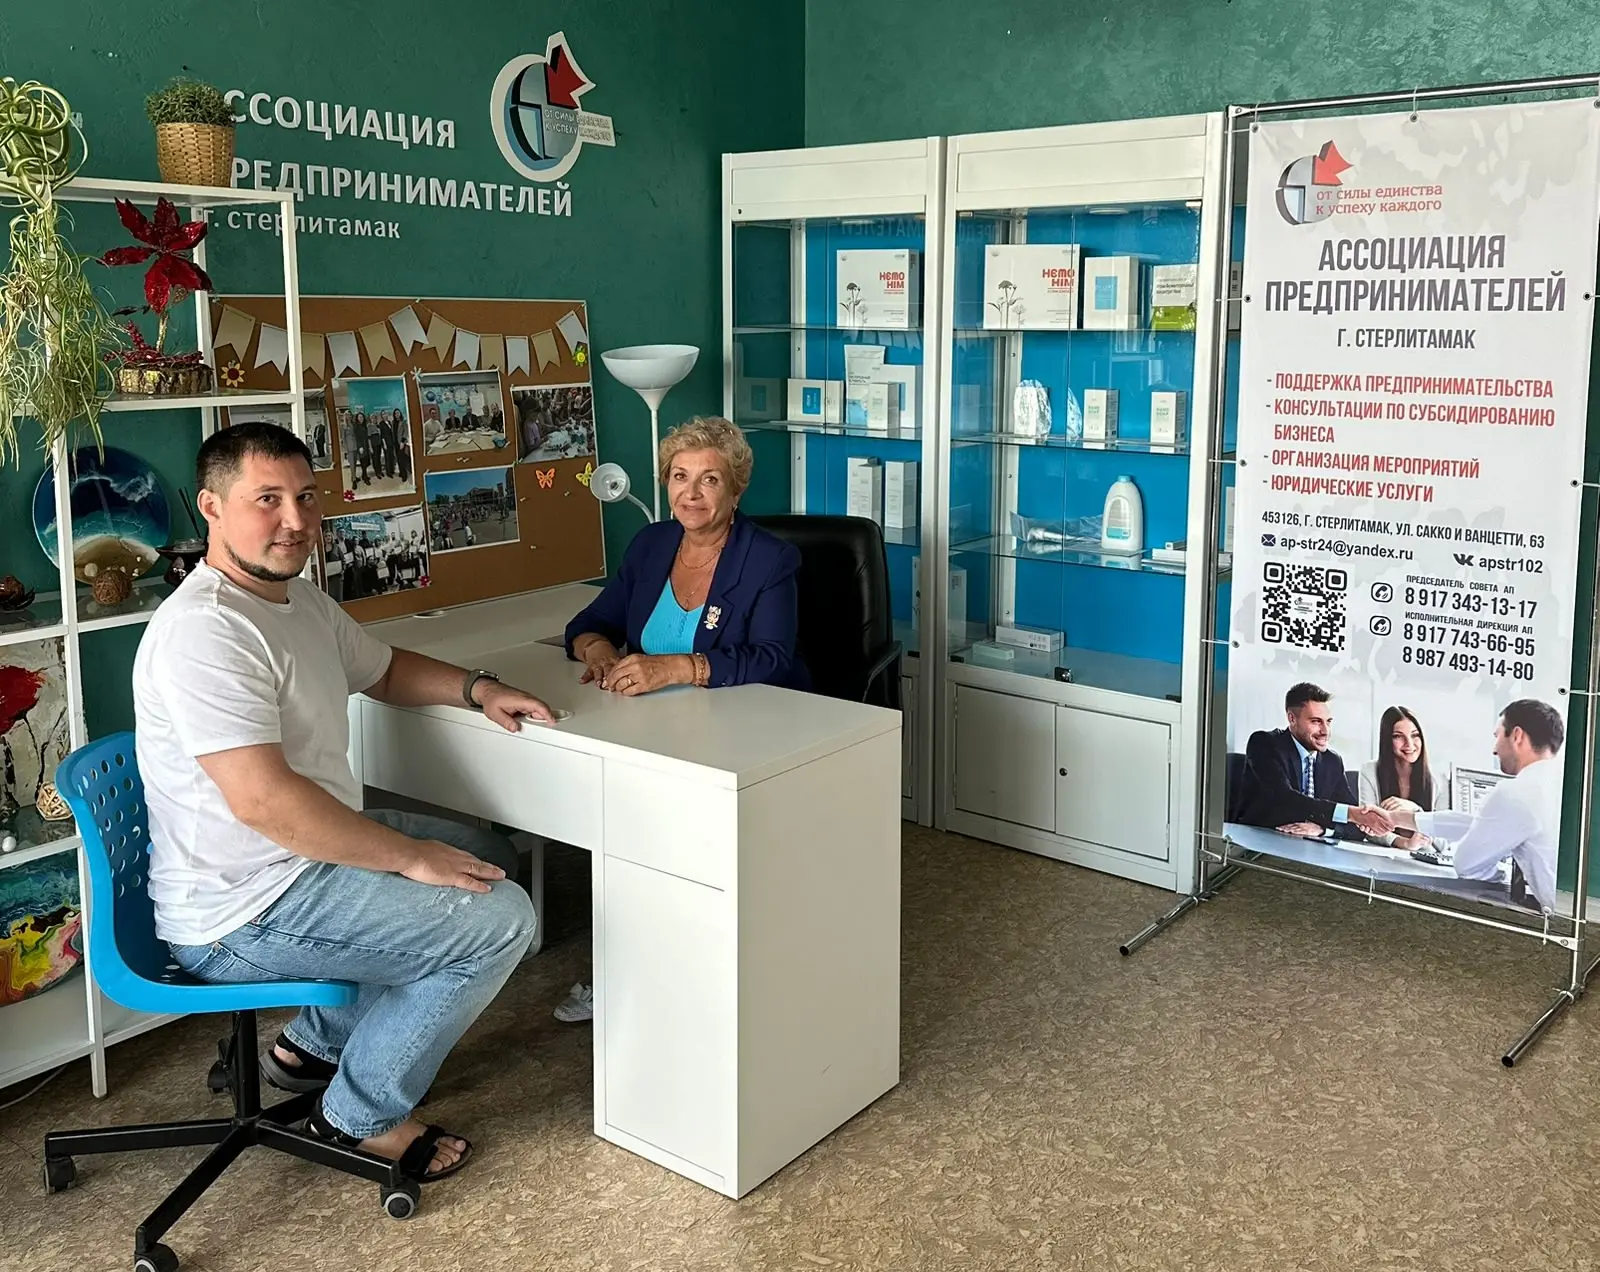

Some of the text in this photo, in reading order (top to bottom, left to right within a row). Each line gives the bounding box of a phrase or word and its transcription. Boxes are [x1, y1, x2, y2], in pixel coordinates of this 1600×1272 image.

[223, 89, 456, 149] ССОЦИАЦИЯ
[231, 157, 573, 217] РЕДПРИНИМАТЕЛЕЙ
[1317, 185, 1442, 200] от силы единства
[1316, 200, 1441, 217] к успеху каждого
[1318, 235, 1505, 273] АССОЦИАЦИЯ
[1266, 270, 1565, 315] ПРЕДПРИНИМАТЕЛЕЙ
[1338, 329, 1476, 349] Г. СТЕРЛИТАМАК
[1276, 373, 1361, 392] ПОДДЕРЖКА
[1366, 376, 1553, 397] ПРЕДПРИНИМАТЕЛЬСТВА
[1275, 399, 1382, 420] КОНСУЛЬТАЦИИ
[1387, 403, 1405, 420] ПО
[1409, 404, 1554, 426] СУБСИДИРОВАНИЮ
[1275, 424, 1334, 443] БИЗНЕСА
[1272, 450, 1369, 472] ОРГАНИЗАЦИЯ
[1374, 456, 1479, 478] МЕРОПРИЯТИЙ
[1272, 475, 1373, 497] ЮРИДИЧЕСКИЕ
[1377, 482, 1433, 502] УСЛУГИ
[1262, 511, 1544, 548] 453126, Г. СТЕРЛИТАМАК, УЛ. САККО И ВАНЦЕТТИ, 63
[1281, 538, 1413, 560] ap-str24@yandex.ru
[1479, 558, 1542, 573] apstr102
[1407, 575, 1514, 594] ПРЕДСЕДАТЕЛЬ СОВЕТА АП
[1406, 587, 1538, 619] 8 917 343-13-17
[1404, 611, 1532, 634] ИСПОЛНИТЕЛЬНАЯ ДИРЕКЦИЯ АП
[1404, 623, 1535, 656] 8 917 743-66-95
[1403, 646, 1534, 680] 8 987 493-14-80
